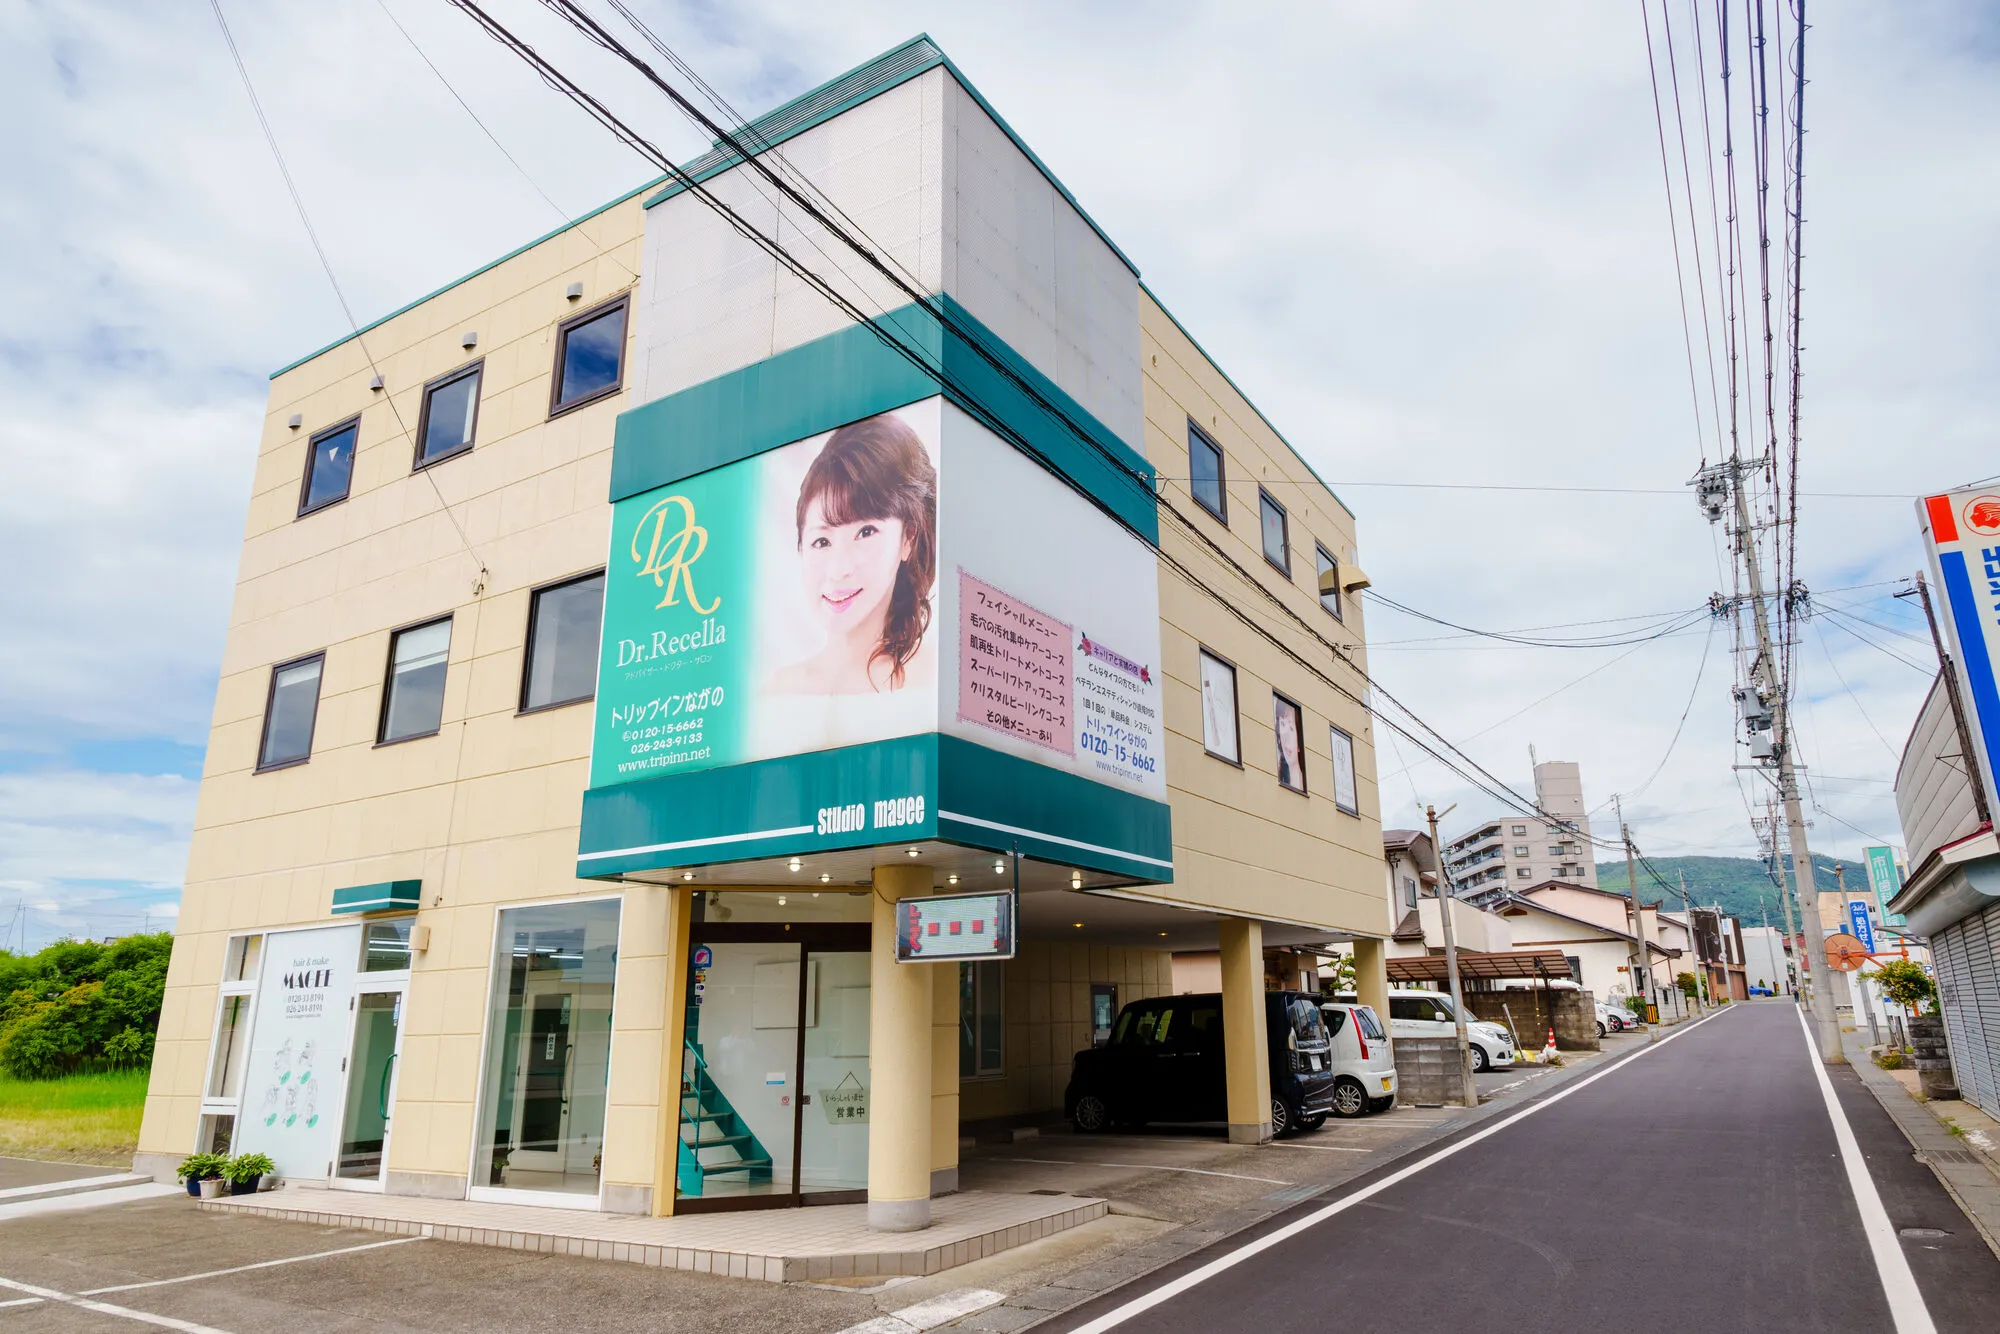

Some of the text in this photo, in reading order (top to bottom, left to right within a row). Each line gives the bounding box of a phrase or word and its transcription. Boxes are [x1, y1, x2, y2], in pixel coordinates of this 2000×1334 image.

[976, 591, 1058, 637] フェイシャルメニュー
[970, 612, 1065, 667] 毛穴の汚れ集中ケアーコース
[970, 634, 1065, 687] 肌再生トリートメントコース
[970, 657, 1066, 707] スーパーリフトアップコース
[611, 686, 724, 728] トリップインながの
[970, 680, 1066, 728] クリスタルピーリングコース
[630, 732, 703, 755] 026-243-9133
[631, 717, 704, 741] 0120-15-6662
[986, 709, 1052, 743] その他メニューあり
[1086, 713, 1148, 751] トリップインながの
[617, 746, 711, 773] www.tripinn.net
[1081, 731, 1156, 773] 0120-15-6662
[1095, 759, 1144, 784] www.tripinn.net
[817, 795, 925, 835] studio magee
[281, 968, 335, 990] MAGEE
[836, 1105, 865, 1119] 営業中
